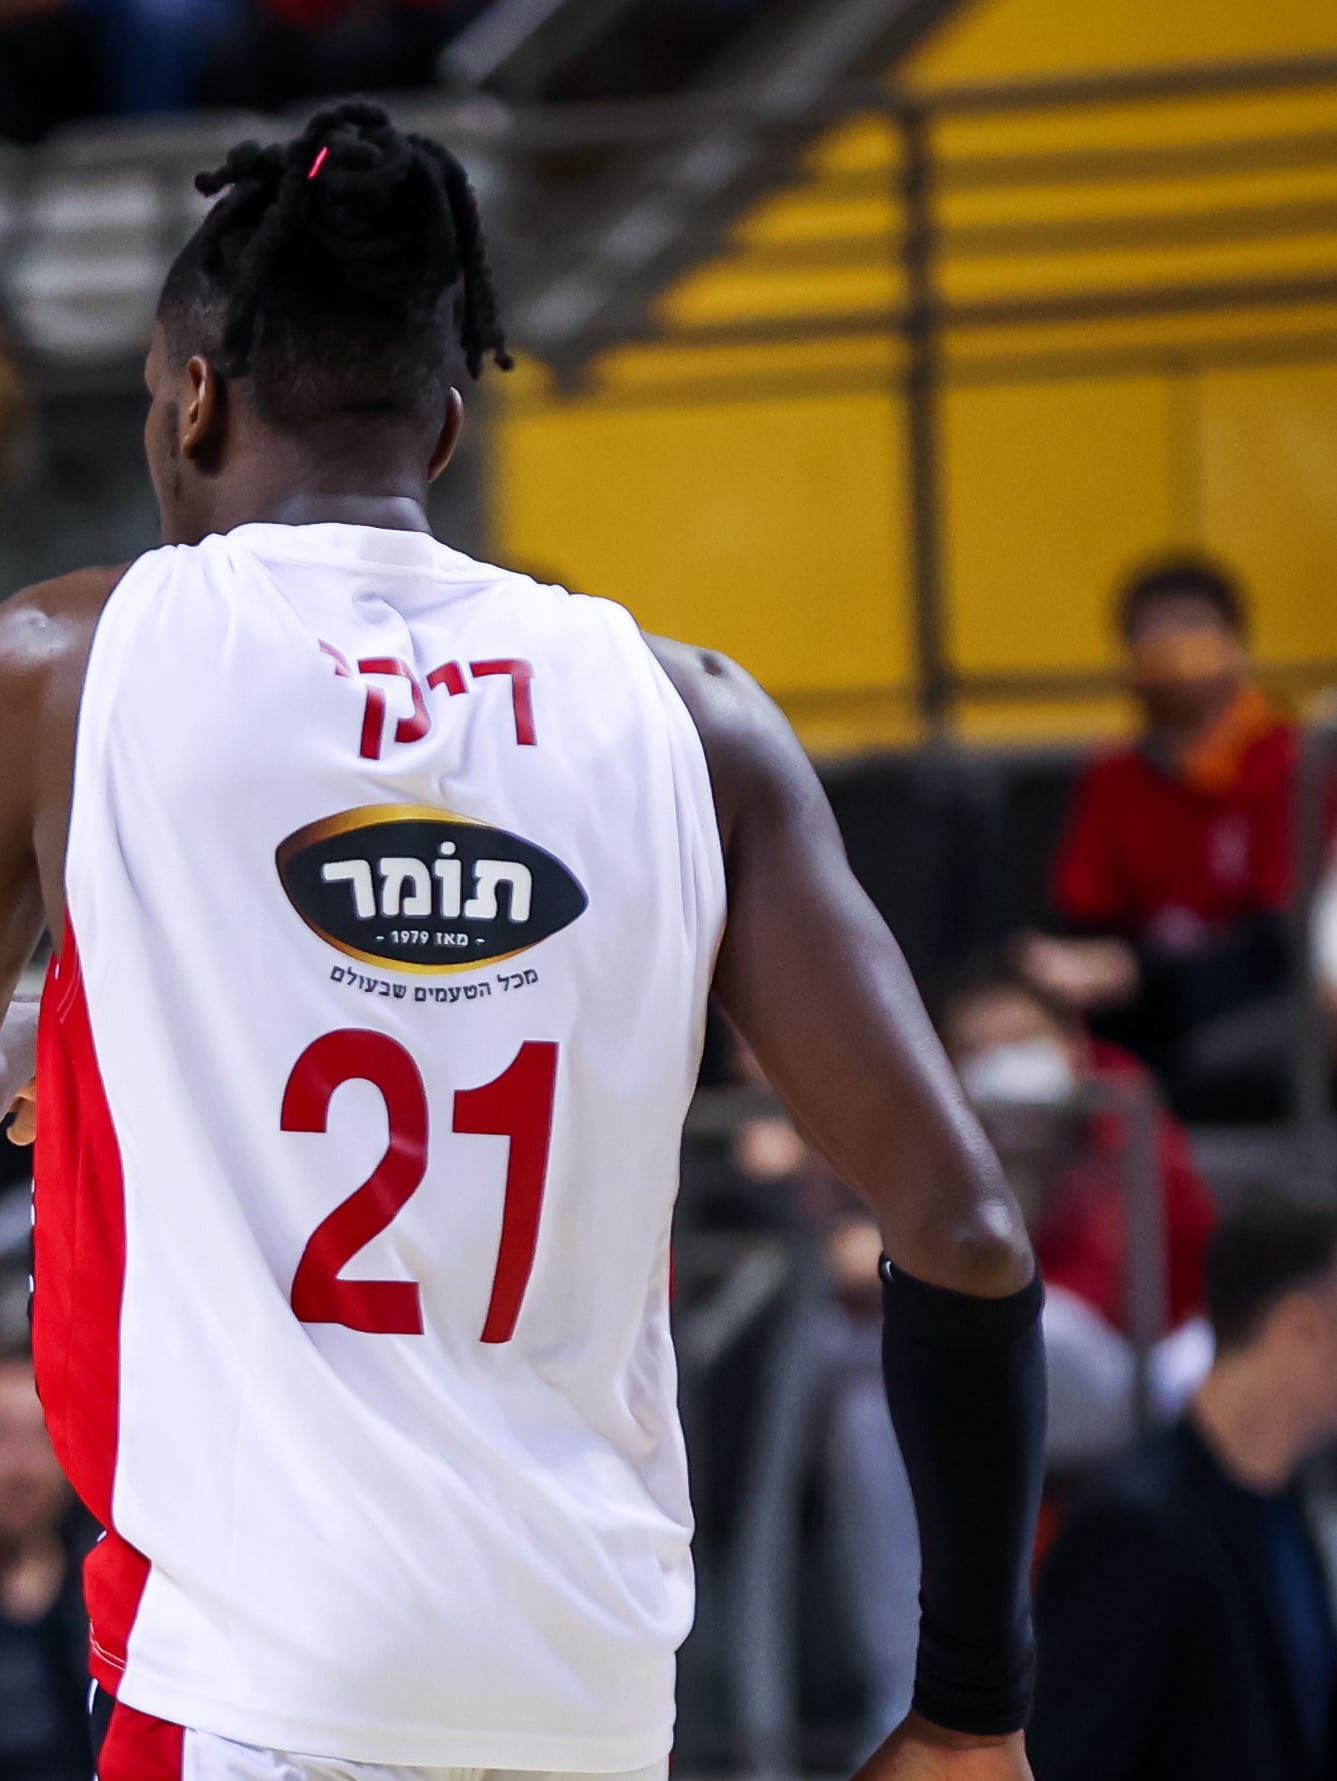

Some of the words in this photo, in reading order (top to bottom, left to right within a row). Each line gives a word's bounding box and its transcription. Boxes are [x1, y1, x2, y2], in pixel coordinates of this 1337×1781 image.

[391, 930, 429, 945] 1979
[435, 931, 469, 946] מאז
[330, 965, 407, 999] שבעולם
[497, 968, 539, 991] מכל
[414, 981, 492, 1003] הטעמים
[280, 1027, 559, 1344] 21
